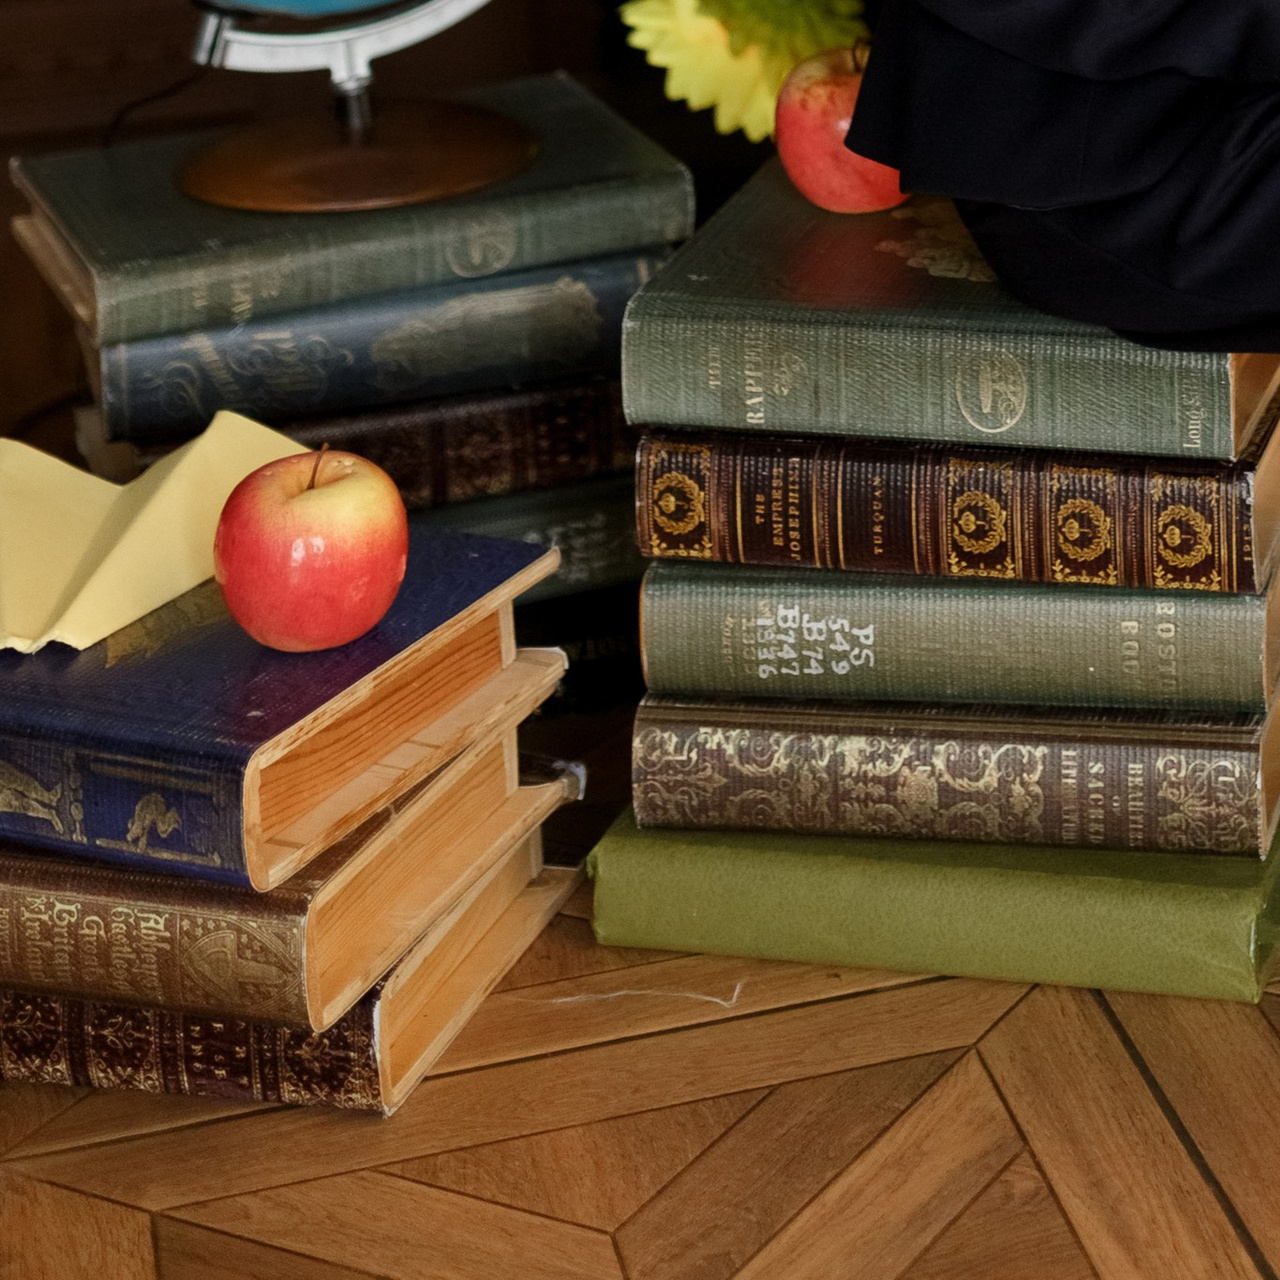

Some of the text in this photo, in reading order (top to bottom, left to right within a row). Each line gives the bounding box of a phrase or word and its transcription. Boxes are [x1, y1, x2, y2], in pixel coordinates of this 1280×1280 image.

[754, 492, 766, 526] THE
[771, 466, 785, 547] EMPRESS
[872, 475, 885, 556] TURQUAN
[801, 612, 827, 676] B74
[828, 616, 851, 676] 549
[848, 623, 875, 669] PS
